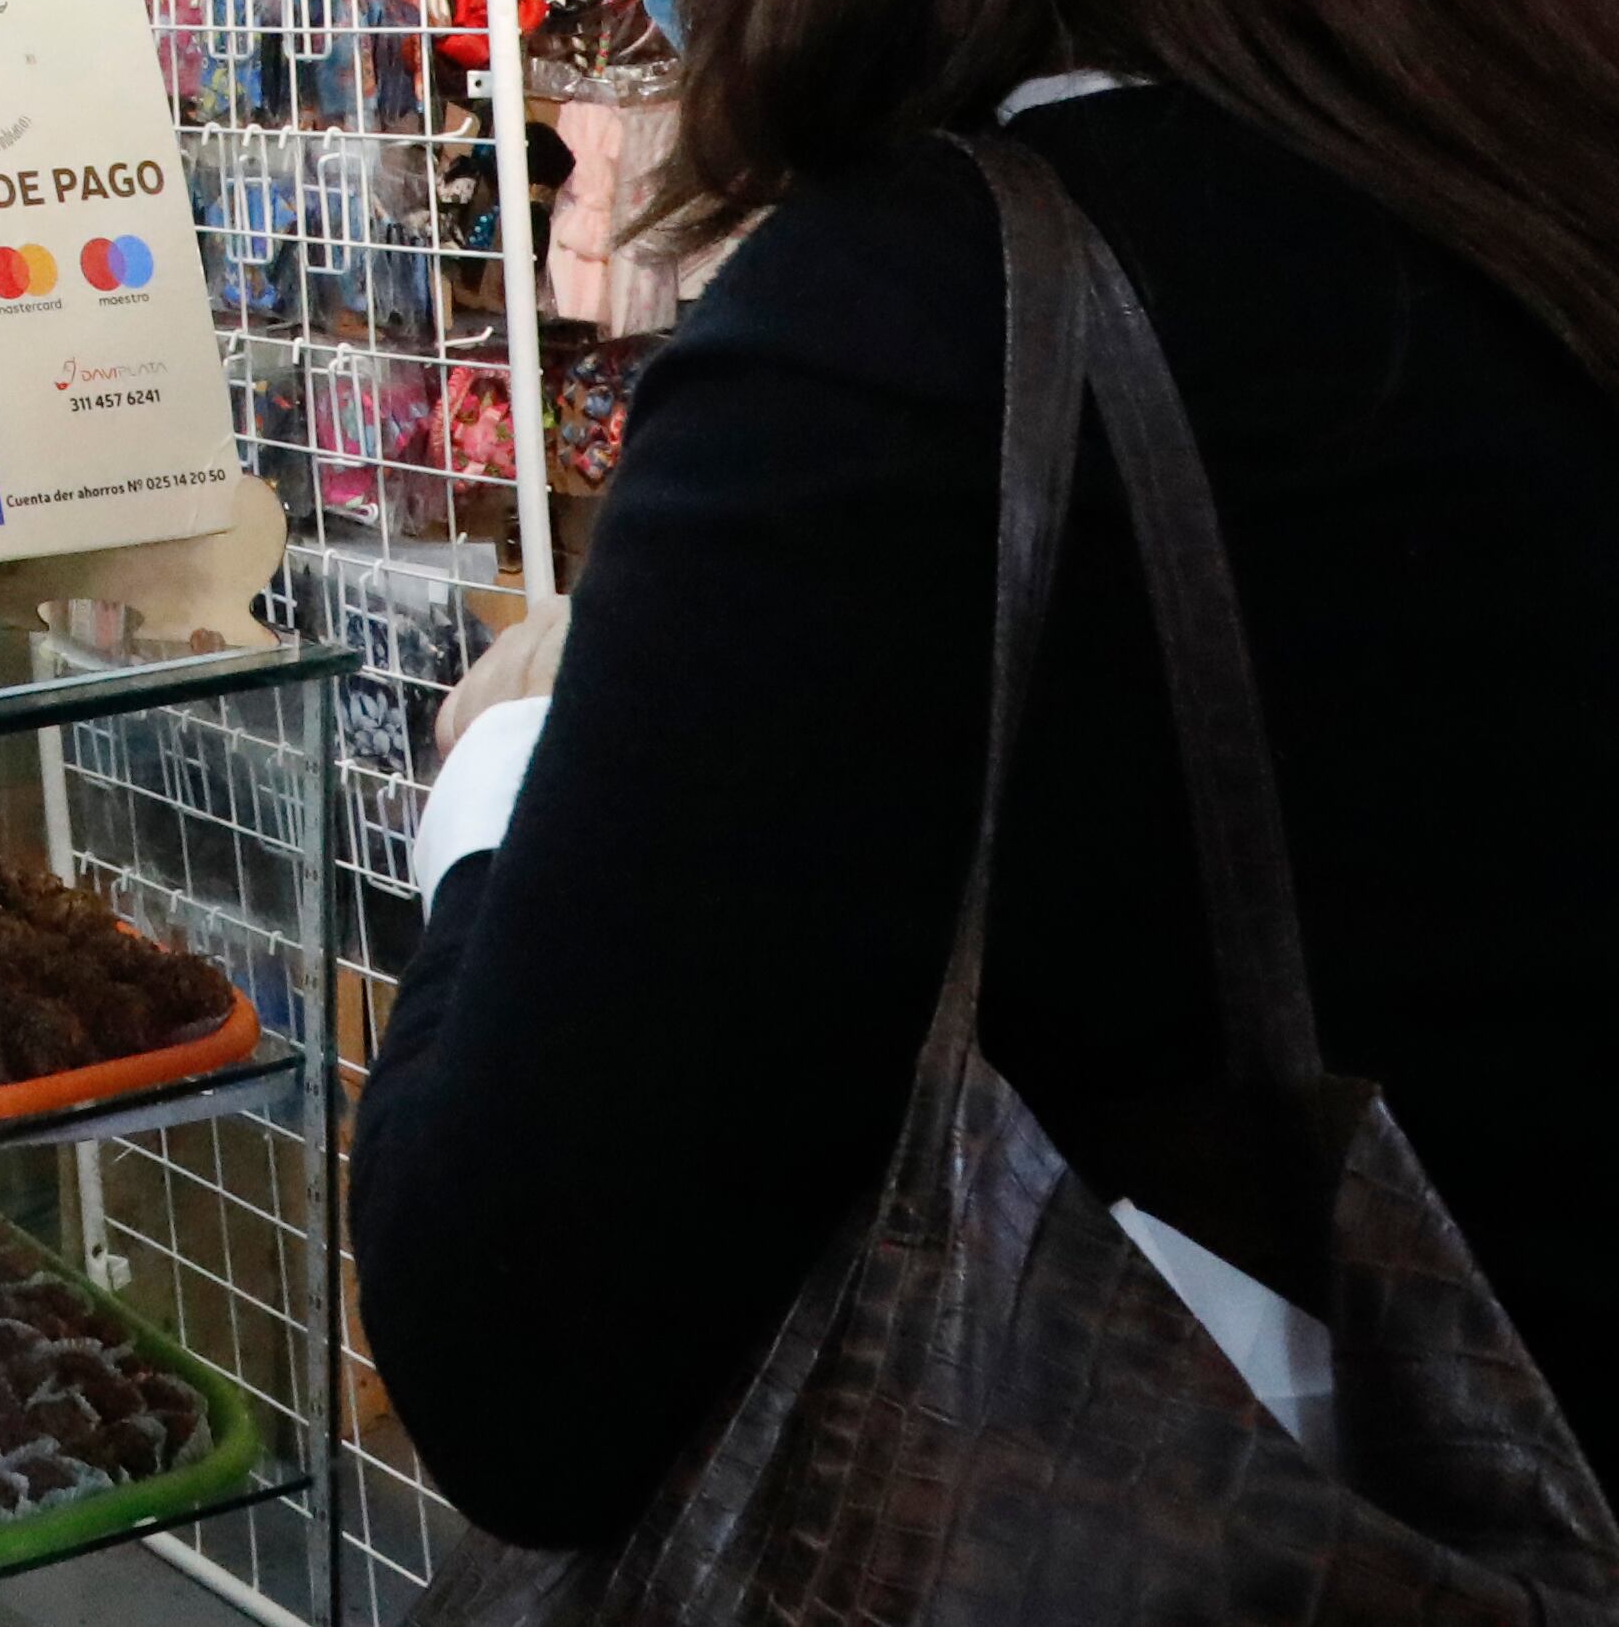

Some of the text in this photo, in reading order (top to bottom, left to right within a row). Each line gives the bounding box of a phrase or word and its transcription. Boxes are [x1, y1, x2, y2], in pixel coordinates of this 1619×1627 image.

[51, 160, 165, 203] PAGO
[98, 292, 151, 308] maestro
[69, 389, 161, 413] 311 457 6241
[5, 492, 51, 509] Cuenta
[53, 488, 74, 504] der
[76, 483, 125, 501] ahorros
[145, 475, 172, 491] 025
[172, 472, 188, 487] 14
[188, 470, 207, 486] 20
[207, 468, 227, 484] 50
